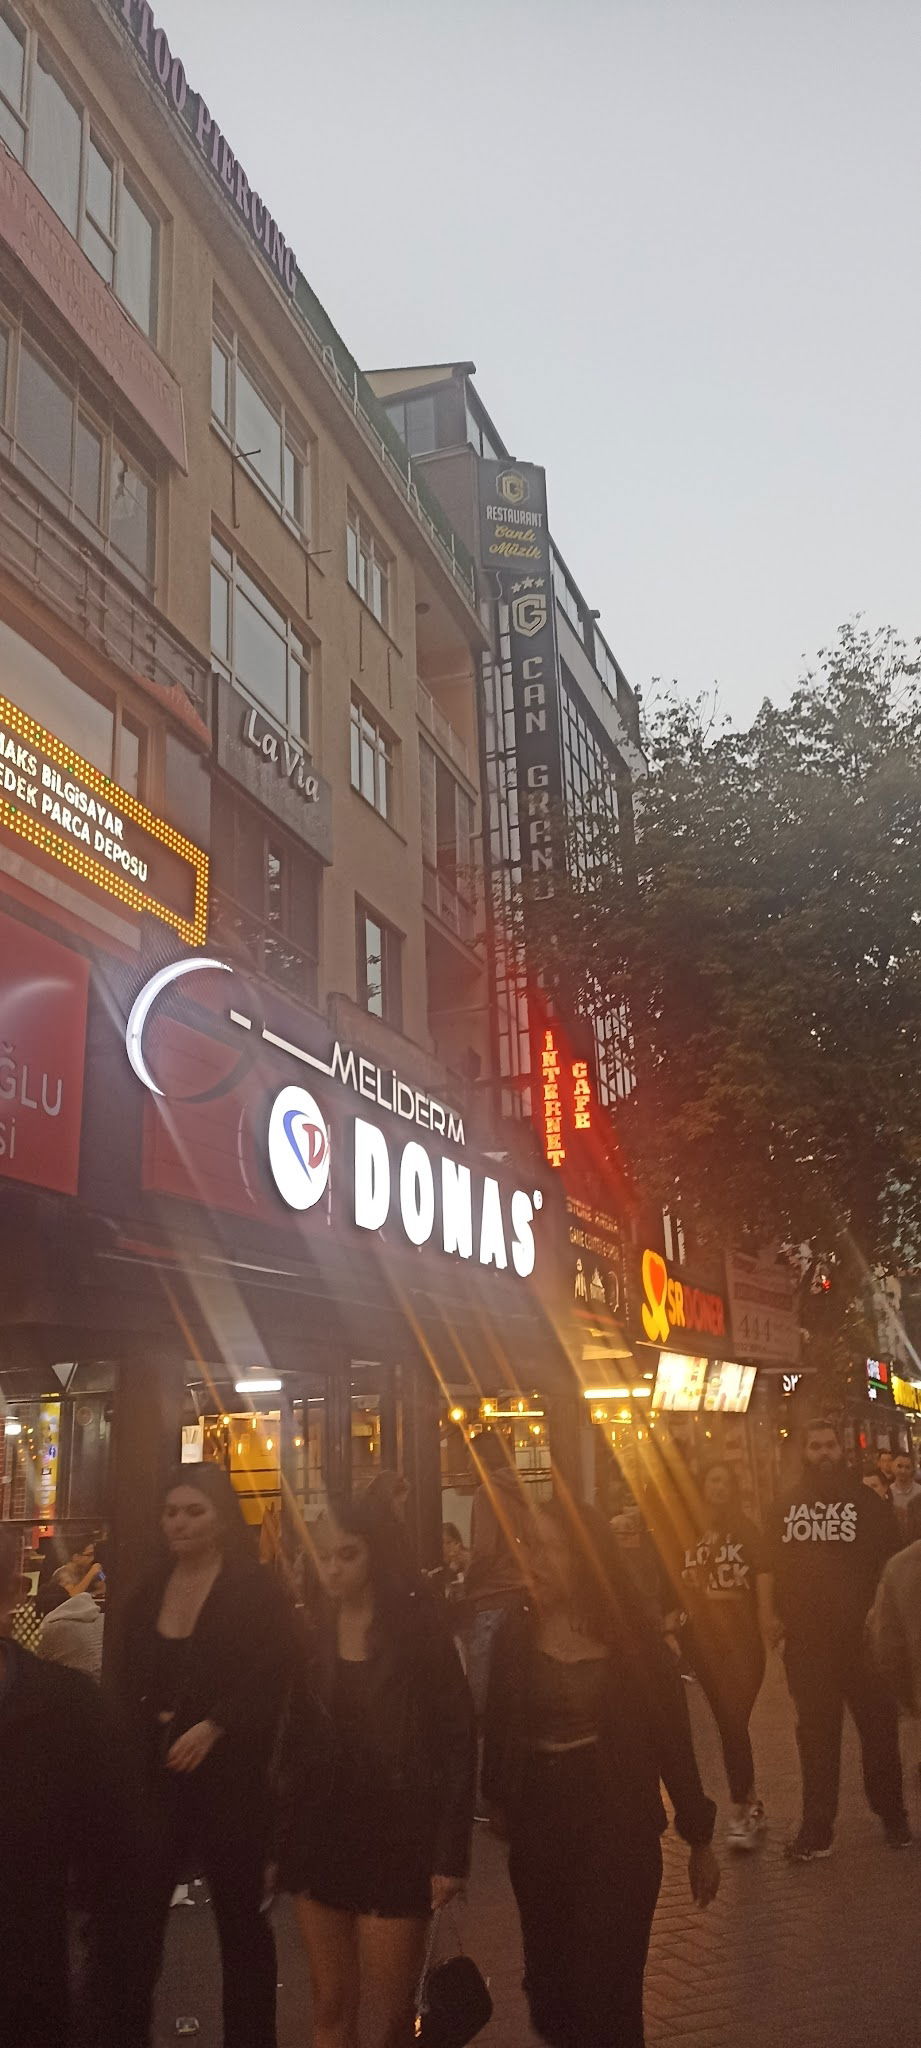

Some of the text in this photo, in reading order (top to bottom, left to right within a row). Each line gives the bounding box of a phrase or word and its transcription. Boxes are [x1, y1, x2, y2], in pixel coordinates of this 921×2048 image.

[195, 96, 298, 291] PIERCING
[486, 505, 543, 528] RESTAURANT
[489, 541, 542, 560] Müzik
[494, 524, 536, 542] Canlı
[522, 656, 547, 734] CAN
[41, 793, 91, 845] PARCA
[94, 829, 148, 883] DEPOSU
[330, 1040, 465, 1146] MELİDERM
[355, 1117, 536, 1278] DONAS
[781, 1520, 857, 1543] JONES
